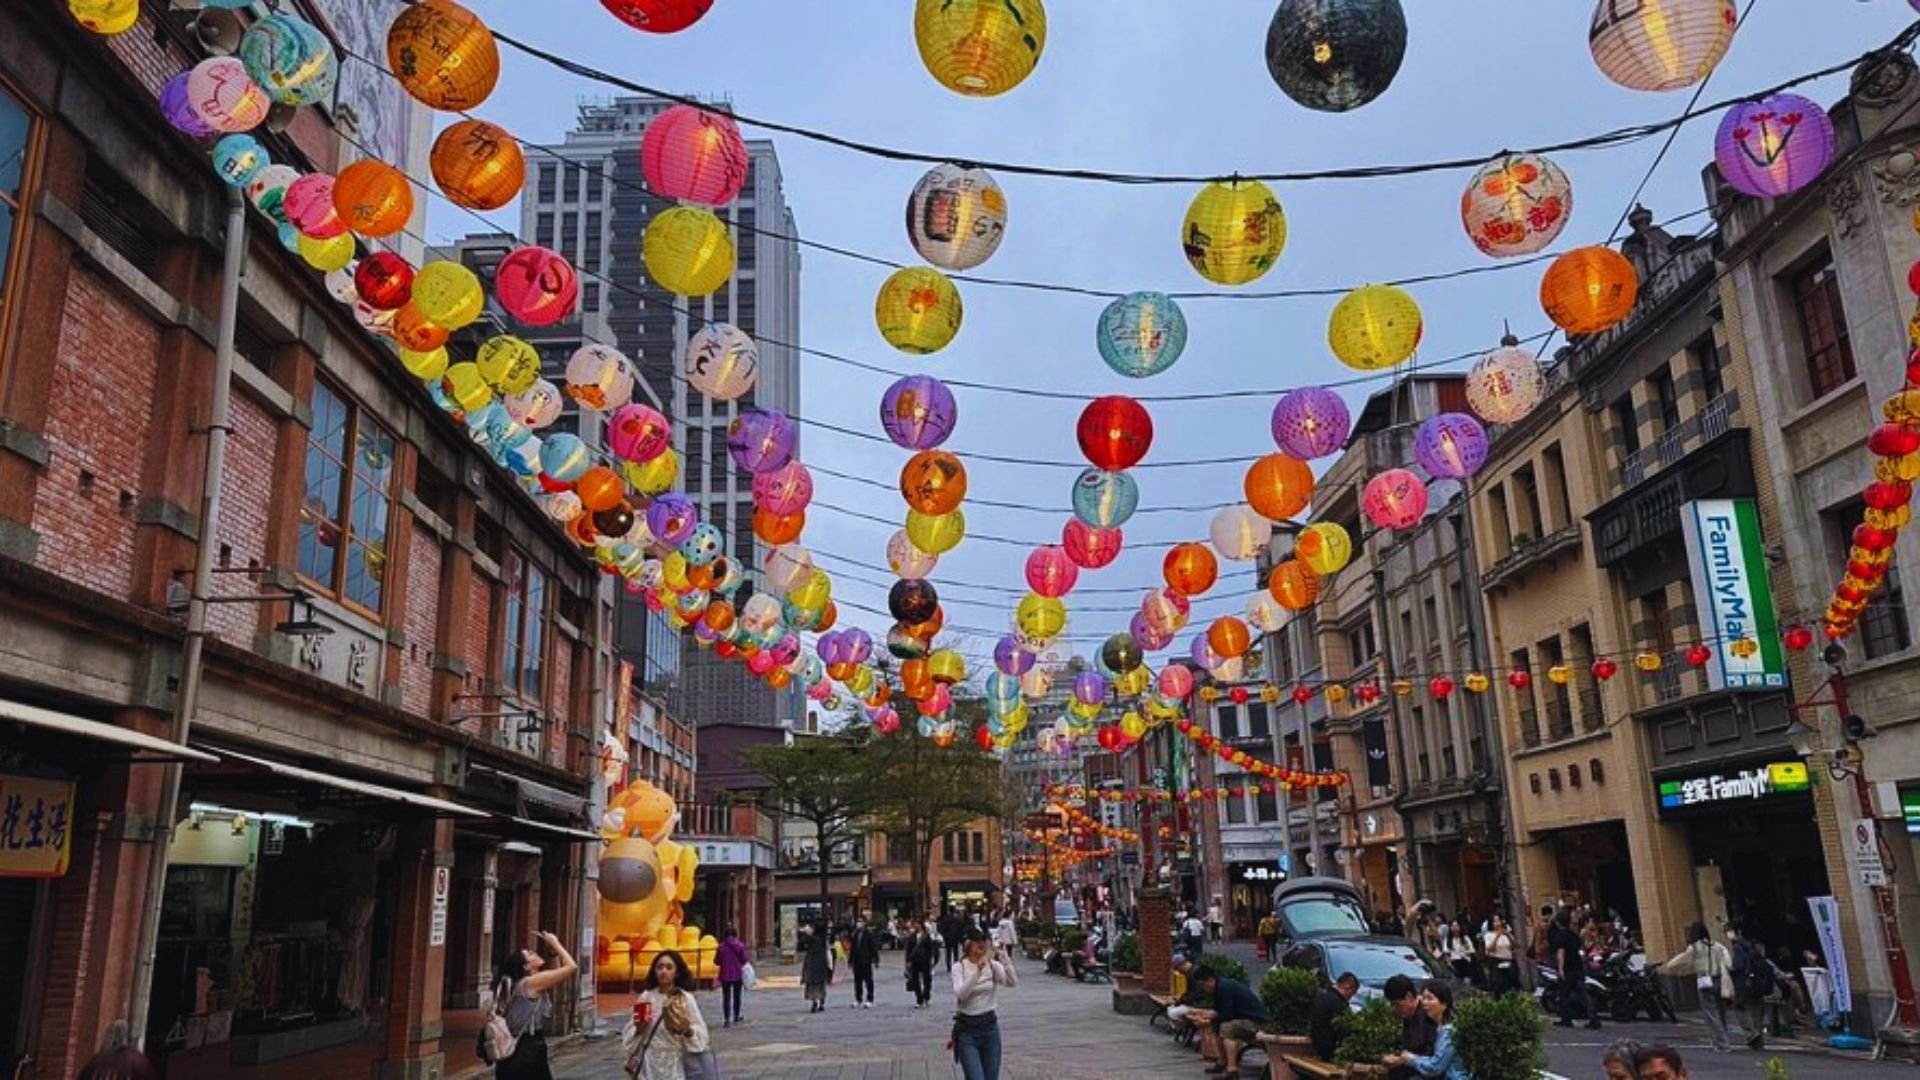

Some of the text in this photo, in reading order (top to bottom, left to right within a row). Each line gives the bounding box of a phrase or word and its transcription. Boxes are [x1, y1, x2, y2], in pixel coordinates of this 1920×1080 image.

[1707, 515, 1748, 641] FamilyMa
[1682, 768, 1769, 804] 全家 FamilyM
[0, 794, 67, 851] 花生湯
